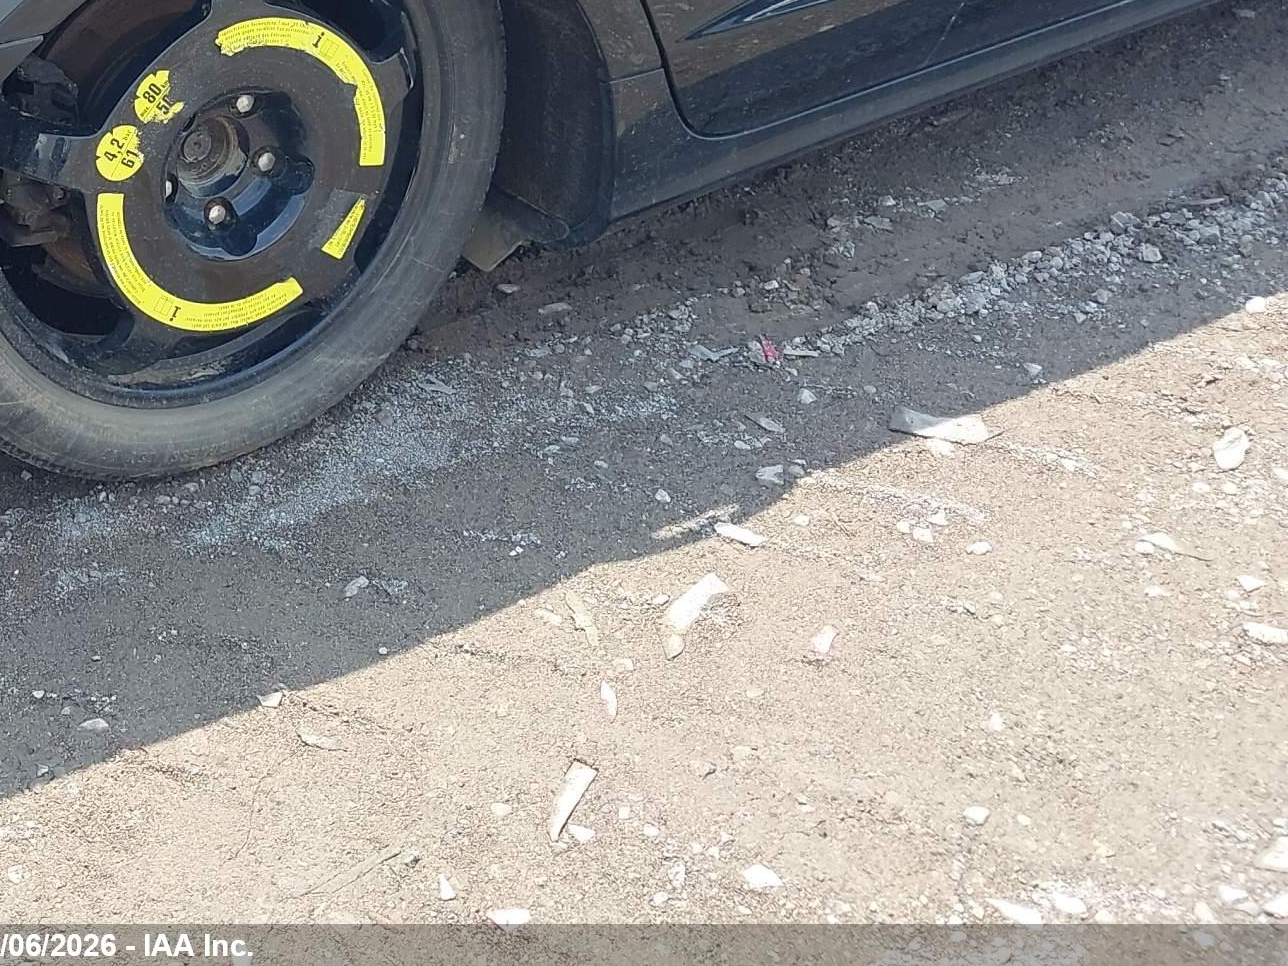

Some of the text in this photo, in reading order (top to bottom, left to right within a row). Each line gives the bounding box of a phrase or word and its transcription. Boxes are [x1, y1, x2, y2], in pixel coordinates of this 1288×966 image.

[142, 83, 162, 104] 80
[103, 138, 125, 162] 4,2
[120, 149, 140, 169] 61
